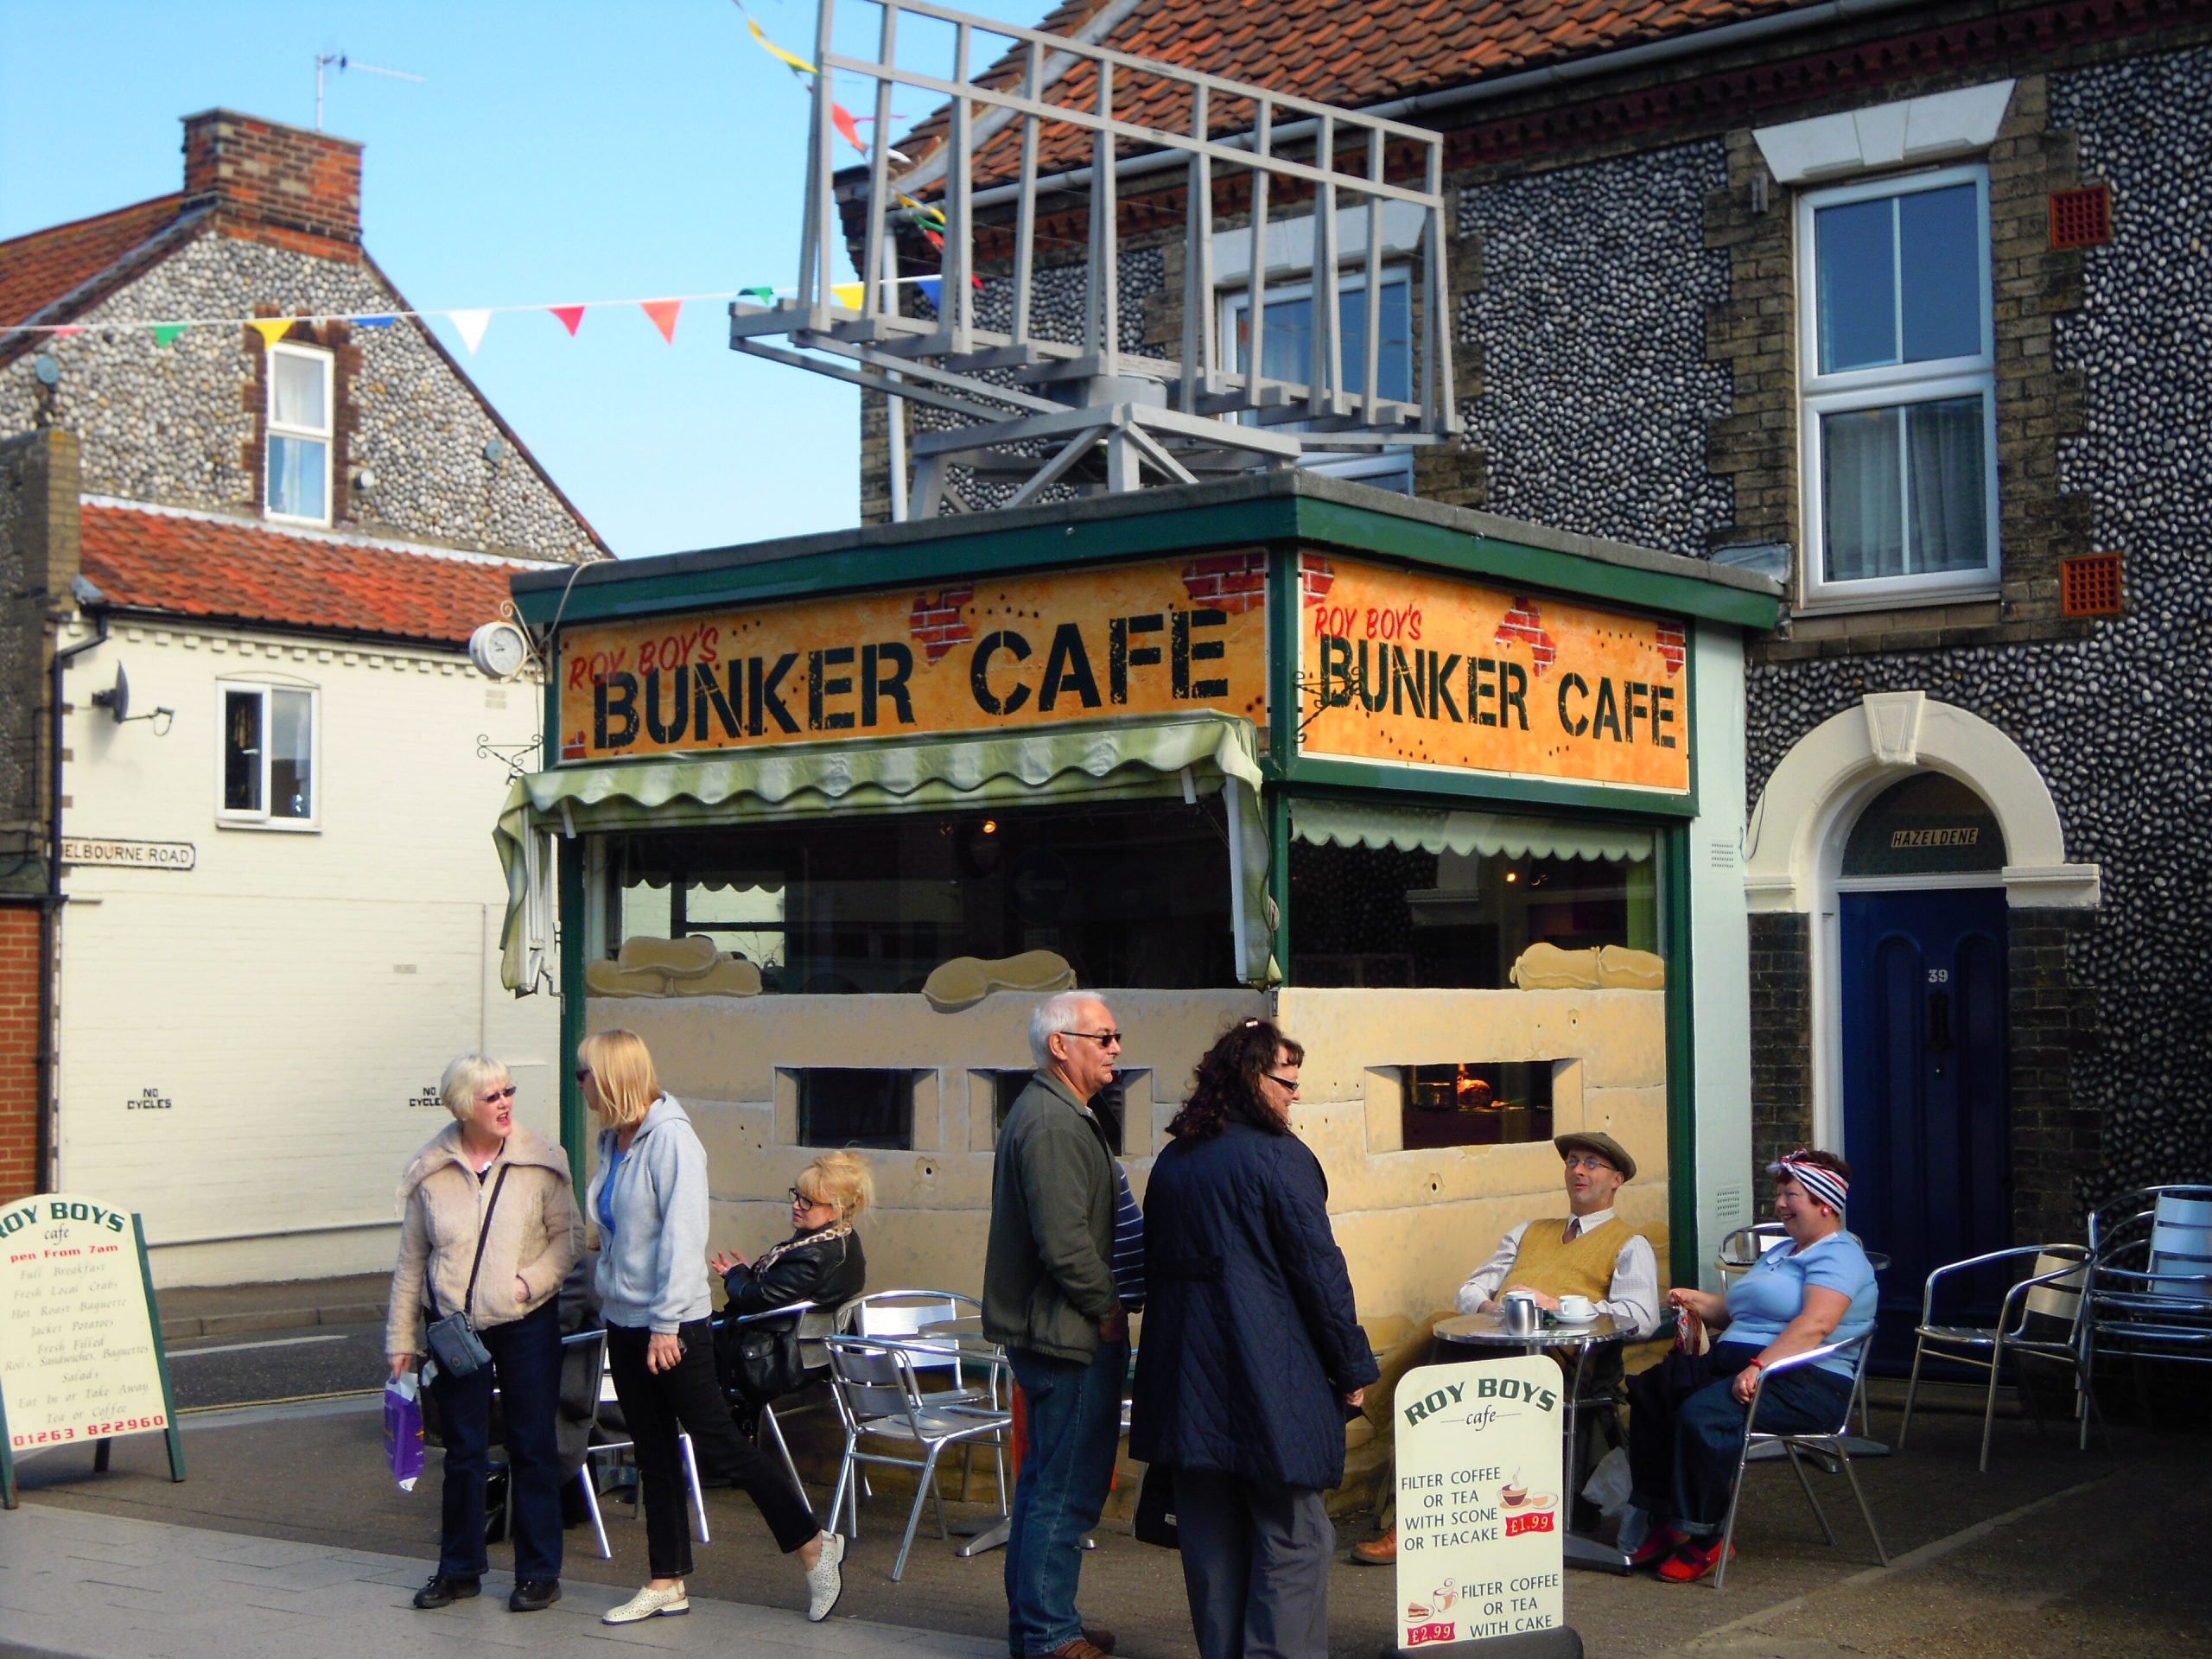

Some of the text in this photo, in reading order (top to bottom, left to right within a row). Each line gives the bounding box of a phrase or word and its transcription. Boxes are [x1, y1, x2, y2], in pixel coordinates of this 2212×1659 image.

[1315, 599, 1422, 641] ROY BOY'S
[569, 623, 719, 691] ROY BOY'S
[594, 607, 1230, 748] BUNKER CAFE
[1319, 634, 1676, 749] BUNKER CAFE
[1893, 829, 1976, 847] HAZELDENE
[61, 843, 190, 863] ELBOURNE ROAD
[1928, 969, 1948, 983] 39
[143, 1088, 159, 1097] NO
[409, 1097, 444, 1107] CYCLE
[423, 1087, 436, 1096] NO
[127, 1098, 172, 1109] CYCLES
[50, 1202, 125, 1233] BOYS
[44, 1224, 70, 1245] cafe
[44, 1249, 81, 1258] From
[89, 1244, 119, 1254] 7am
[1403, 1377, 1557, 1427] ROY BOYS
[1465, 1404, 1497, 1432] cafe
[13, 1414, 165, 1446] 01263 822960
[1401, 1466, 1501, 1491] FILTER COFFEE
[1423, 1490, 1479, 1509] OR TEA
[1405, 1507, 1498, 1530] WITH SCONE
[1511, 1516, 1549, 1534] £1.99
[1404, 1527, 1499, 1551] OR TEACAKE
[1461, 1573, 1559, 1599] FILTER COFFEE
[1483, 1597, 1538, 1616] OR TEA
[1412, 1626, 1452, 1644] £2.99
[1470, 1615, 1553, 1638] WITH CAKE
